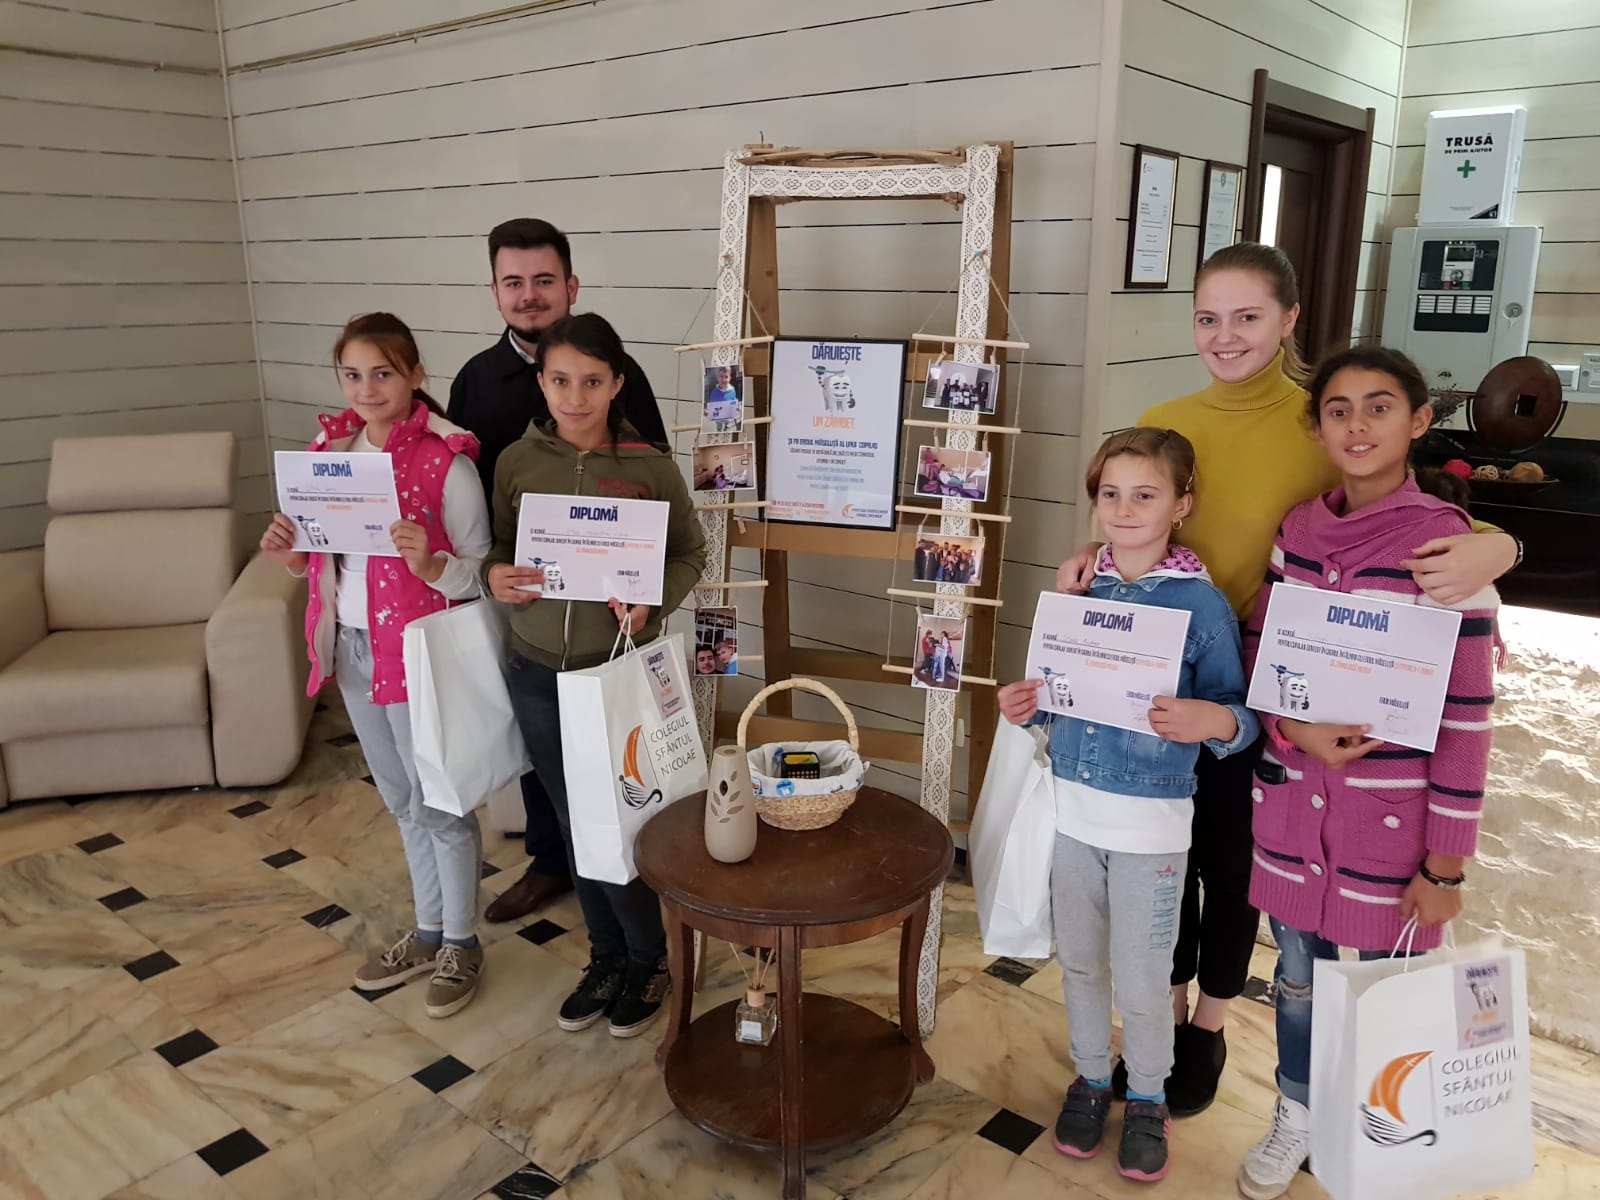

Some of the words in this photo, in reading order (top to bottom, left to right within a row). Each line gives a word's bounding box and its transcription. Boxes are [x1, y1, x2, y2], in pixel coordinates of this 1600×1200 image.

[1446, 132, 1493, 147] TRUSĂ
[812, 342, 862, 365] DĂRUIEȘTE
[312, 460, 352, 477] DIPLOMĂ
[569, 505, 618, 522] DIPLOMĂ
[1083, 610, 1135, 632] DIPLOMĂ
[1327, 605, 1391, 633] DIPLOMĂ
[650, 715, 690, 743] COLEGIUL
[655, 733, 693, 761] SFÂNTUL
[660, 748, 697, 777] NICOLAE
[1149, 886, 1177, 950] DENVER
